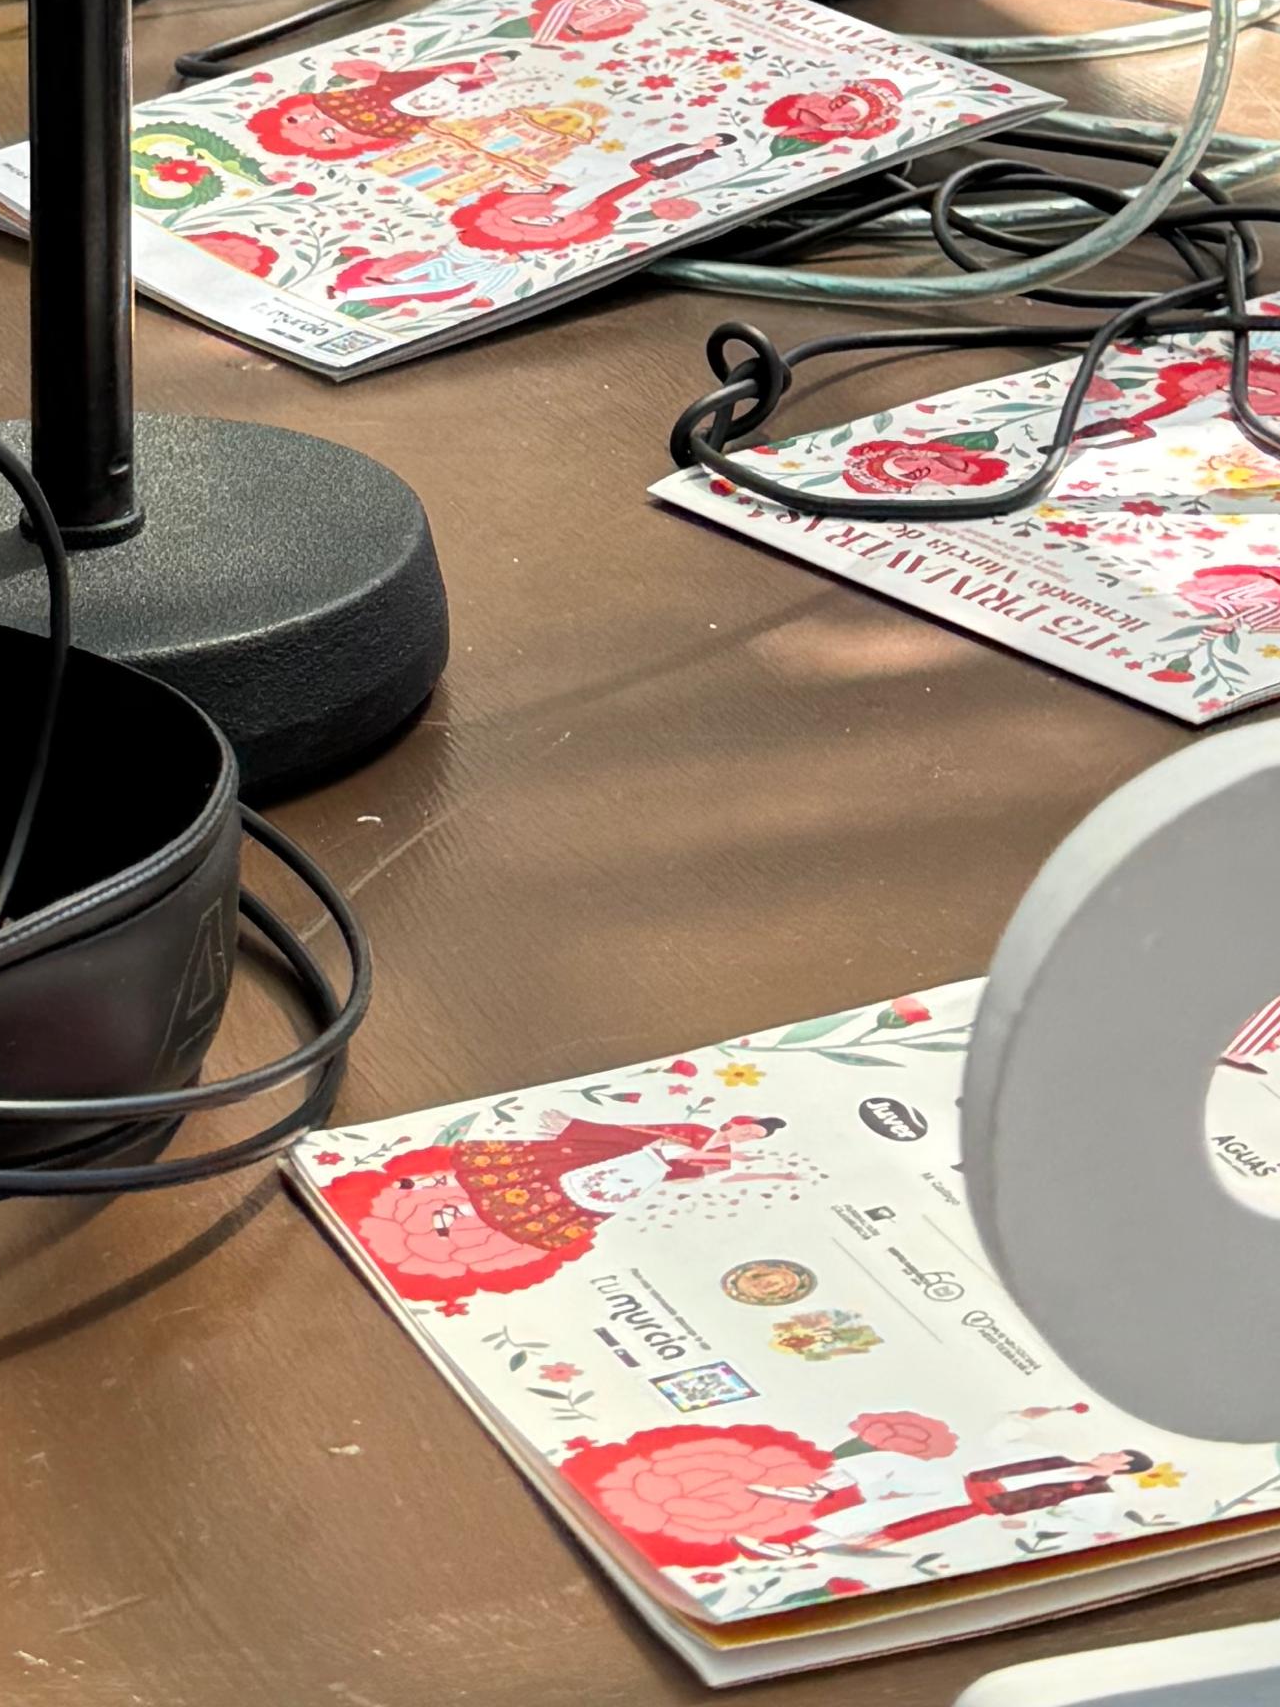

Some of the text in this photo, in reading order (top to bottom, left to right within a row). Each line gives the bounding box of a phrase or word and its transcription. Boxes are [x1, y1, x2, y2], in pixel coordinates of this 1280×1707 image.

[1039, 611, 1120, 653] 175
[865, 1099, 916, 1142] Juver
[1210, 1134, 1277, 1178] AGUAS
